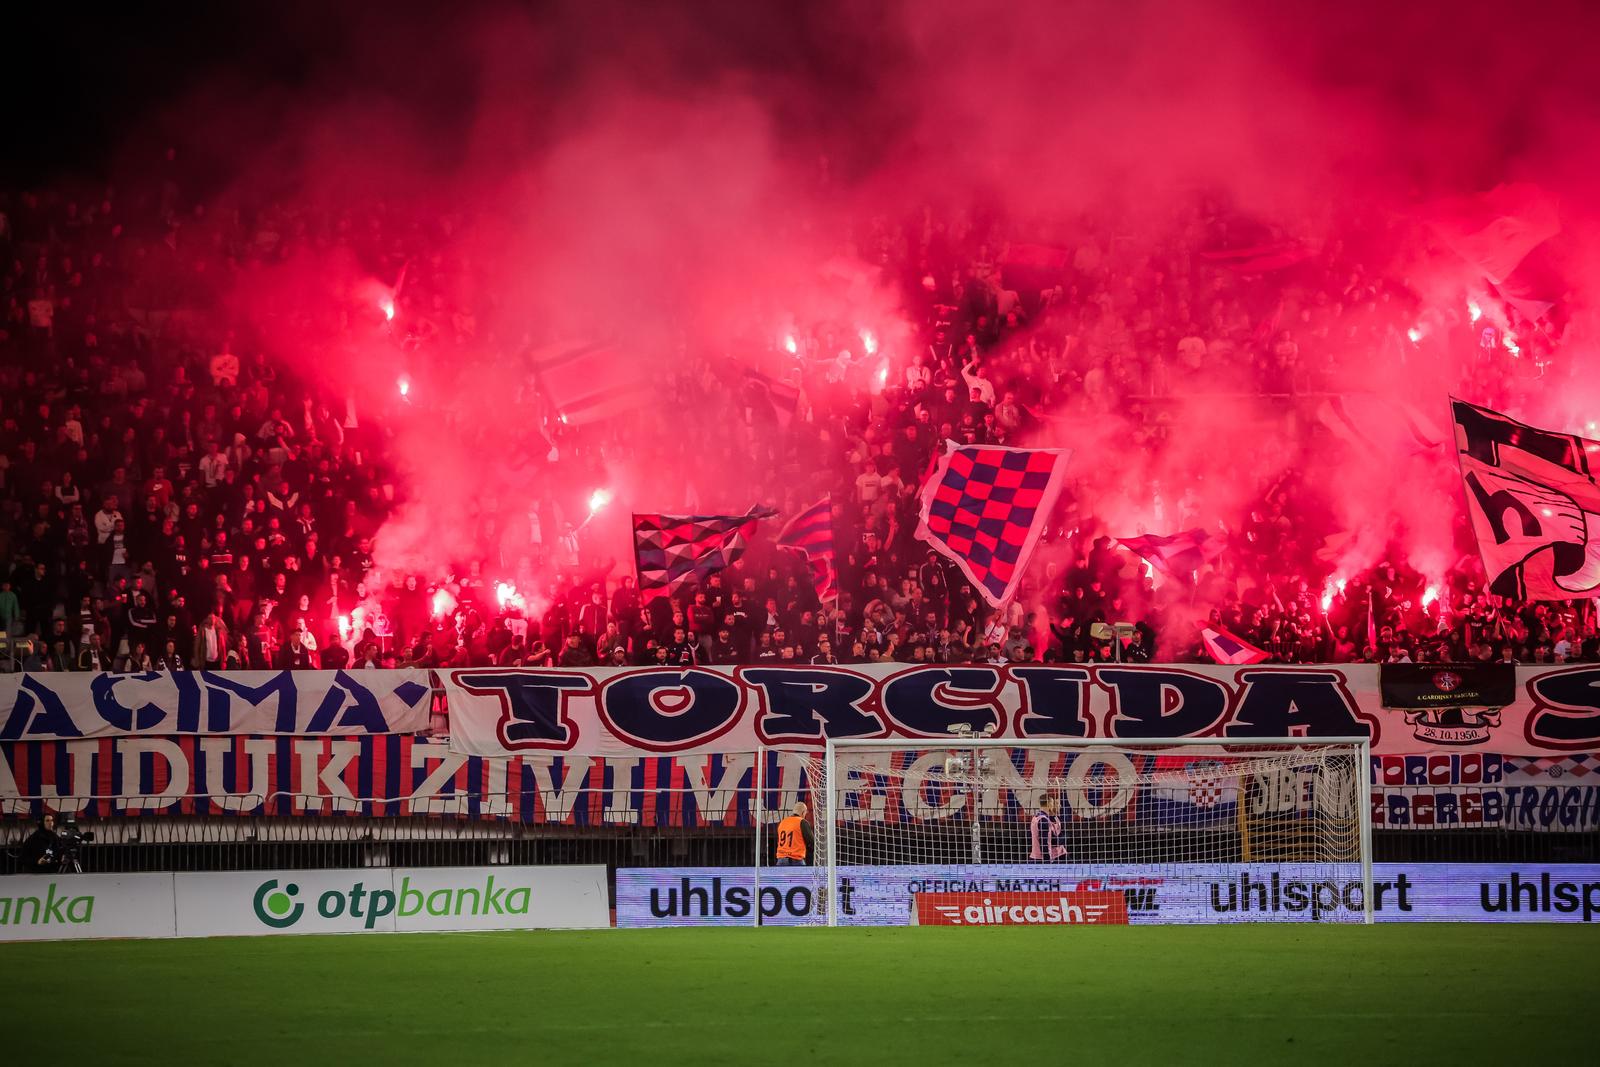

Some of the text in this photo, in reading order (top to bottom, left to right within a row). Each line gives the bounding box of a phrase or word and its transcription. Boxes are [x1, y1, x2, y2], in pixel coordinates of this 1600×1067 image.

[451, 664, 1381, 752] TORCIDA
[780, 830, 794, 848] 91
[907, 880, 1060, 894] OFFICIAL MATCH
[1210, 871, 1413, 921] uhlsport
[963, 897, 1084, 924] aircash
